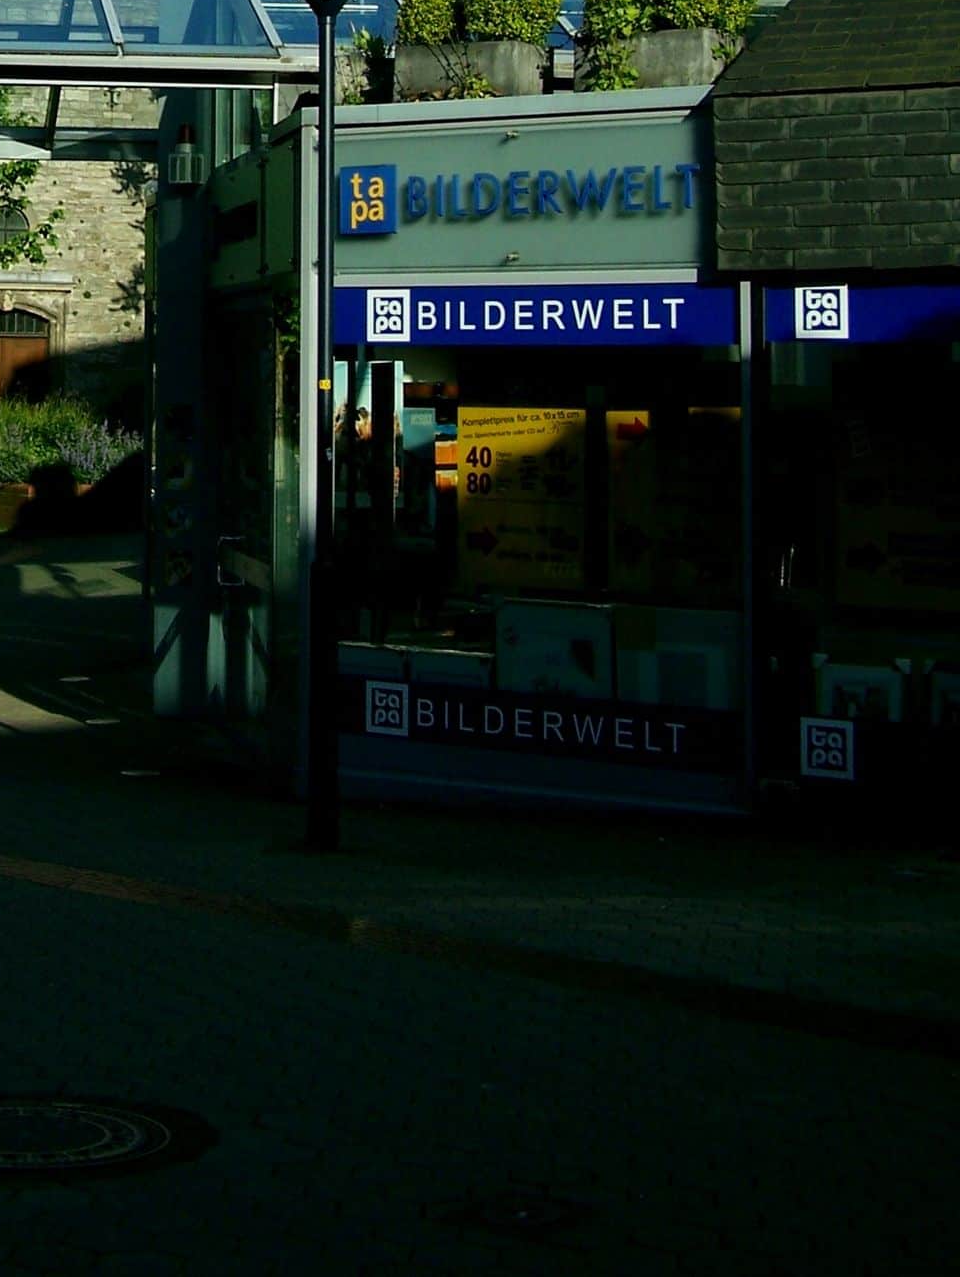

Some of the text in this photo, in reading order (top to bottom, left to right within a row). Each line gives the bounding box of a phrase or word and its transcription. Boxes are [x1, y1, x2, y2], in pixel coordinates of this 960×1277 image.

[407, 164, 700, 219] BILDERWELT
[417, 298, 685, 331] BILDERWELT
[466, 447, 492, 468] 40
[467, 473, 491, 493] 80
[416, 697, 687, 754] BILDERWELT
